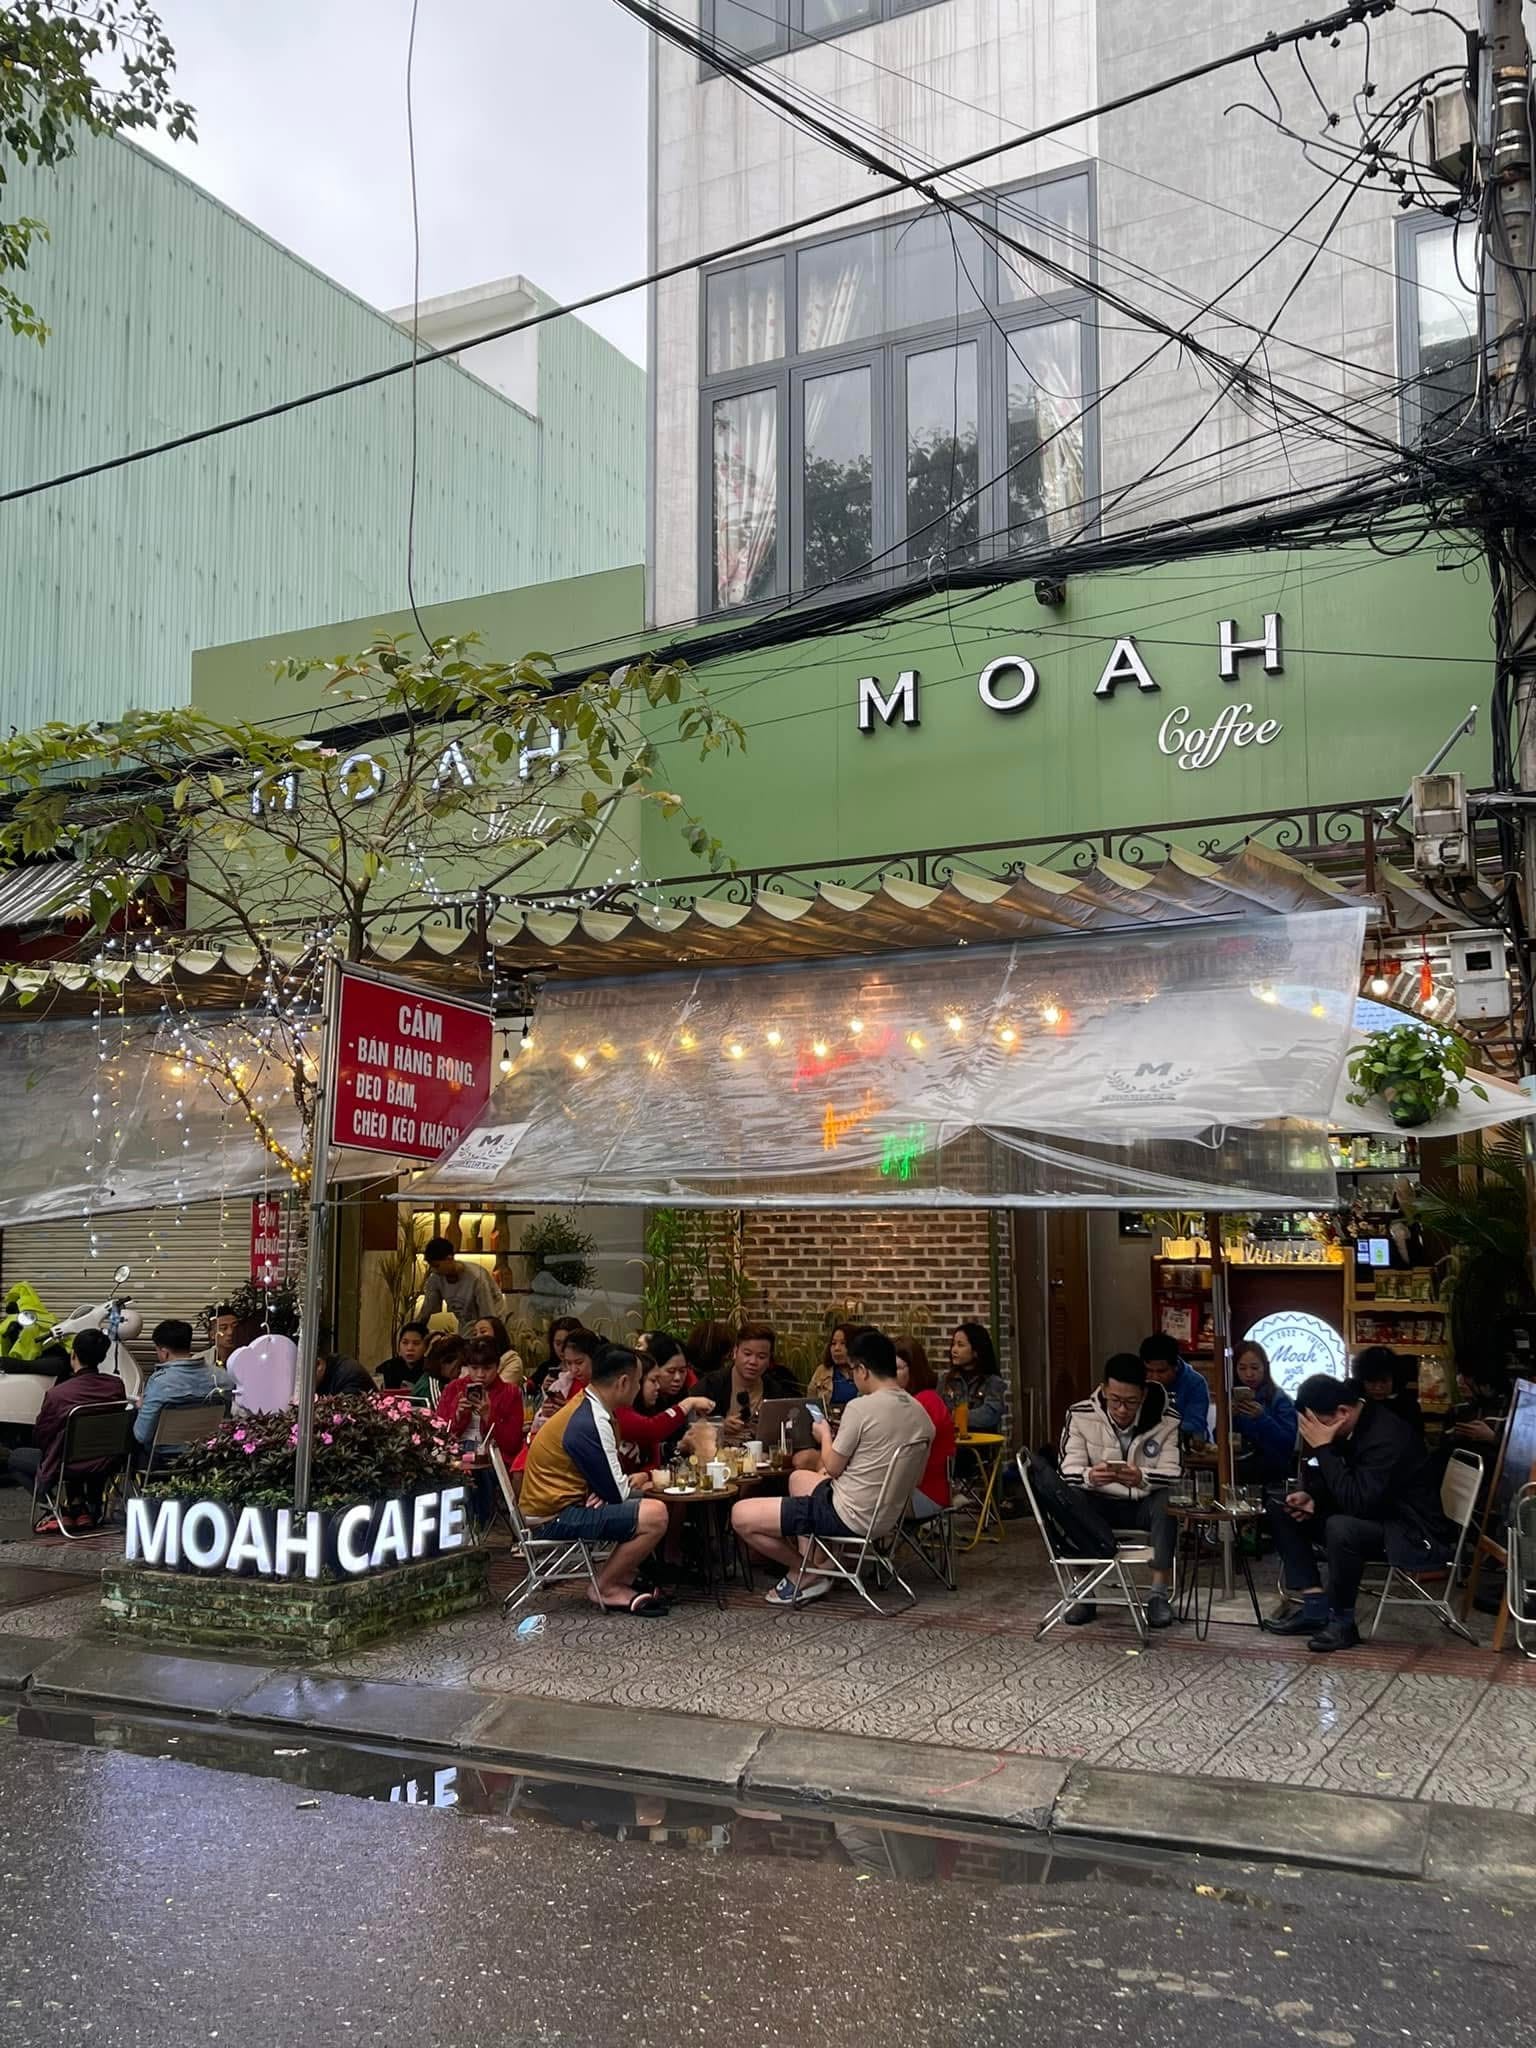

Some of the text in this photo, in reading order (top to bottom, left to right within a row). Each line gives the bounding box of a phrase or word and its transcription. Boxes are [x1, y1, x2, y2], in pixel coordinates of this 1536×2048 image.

[857, 612, 1285, 734] MOAH
[1157, 703, 1283, 771] Coffee
[399, 1003, 442, 1043] CẤM
[358, 1036, 389, 1068] BÁN
[394, 1044, 433, 1078] HÀNG
[391, 1114, 416, 1145] KÉO
[1271, 1341, 1319, 1363] Moah
[124, 1485, 465, 1580] MOAH CAFE
